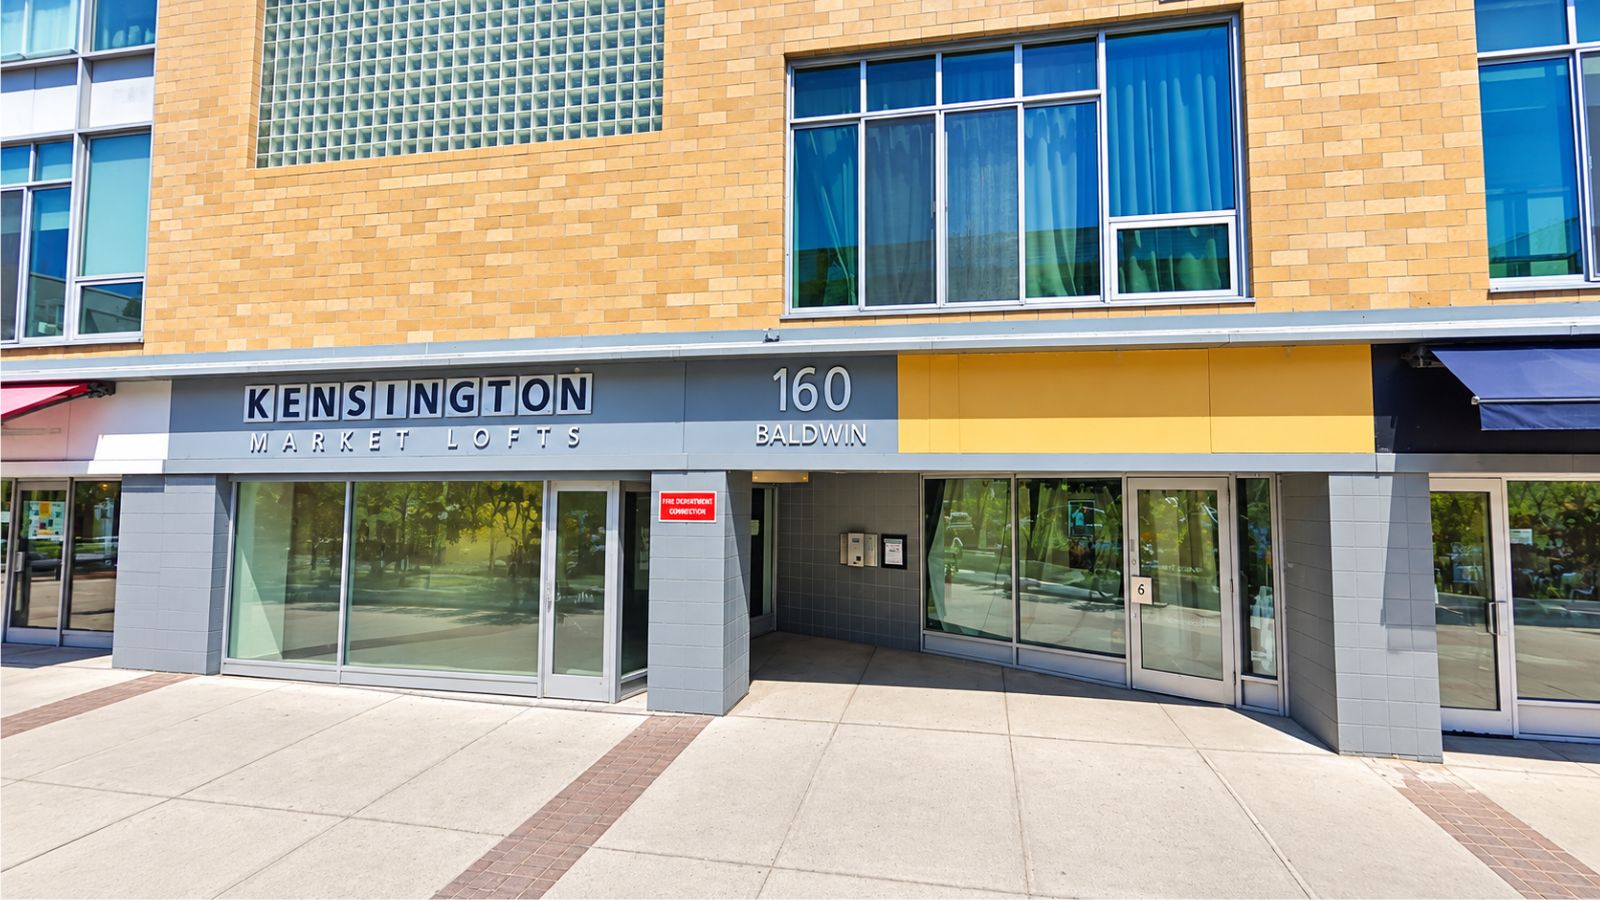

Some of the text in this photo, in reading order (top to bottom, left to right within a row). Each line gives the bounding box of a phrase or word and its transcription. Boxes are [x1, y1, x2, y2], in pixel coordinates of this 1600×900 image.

[247, 377, 587, 419] KENSINGTON
[773, 366, 851, 412] 160
[250, 427, 580, 453] MARKET LOFTS
[756, 423, 867, 447] BALDWIN
[1137, 583, 1145, 596] 6
